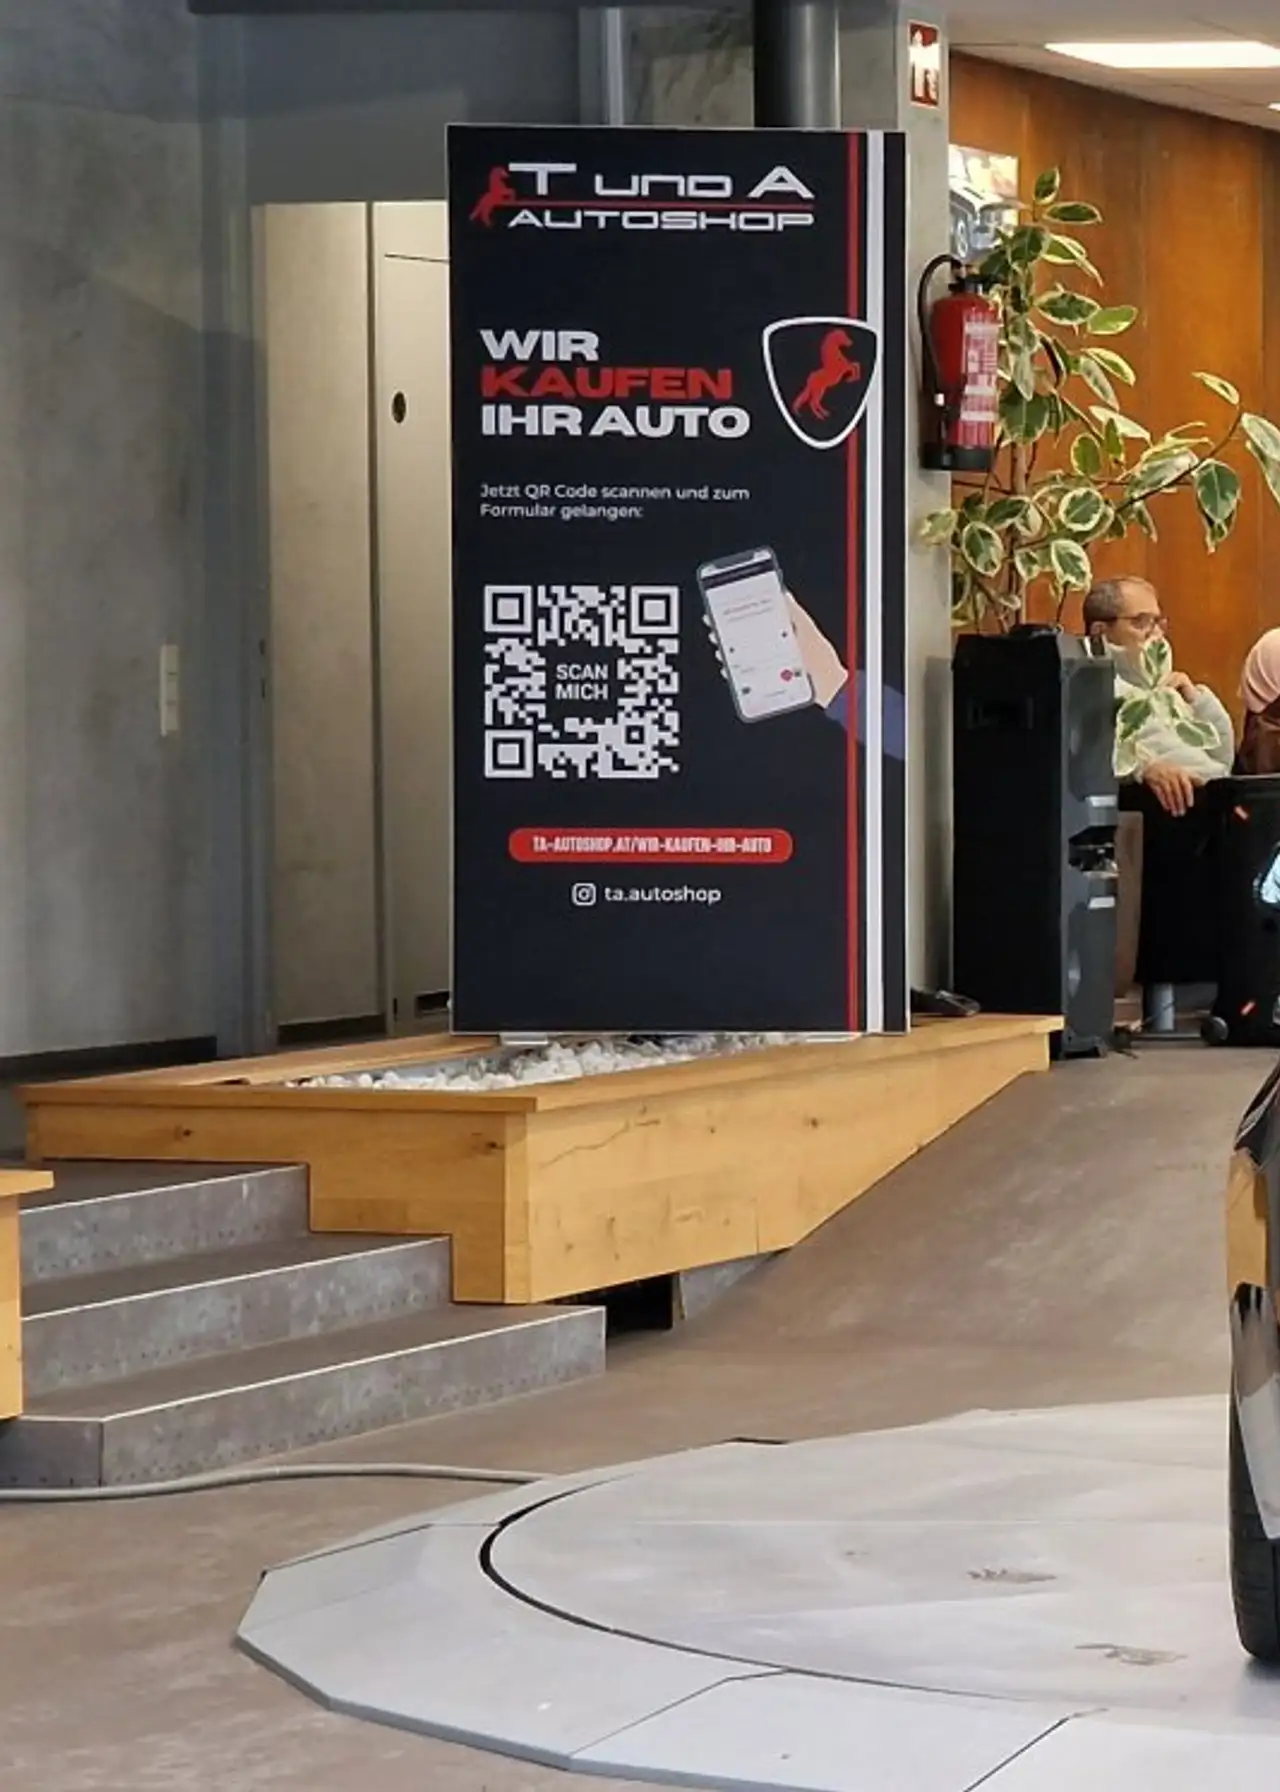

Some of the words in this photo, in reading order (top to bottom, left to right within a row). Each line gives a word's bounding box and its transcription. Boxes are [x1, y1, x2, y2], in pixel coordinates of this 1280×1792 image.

[507, 162, 578, 196] T
[746, 165, 817, 200] A
[507, 208, 816, 232] AUTOSHOP
[479, 329, 600, 362] WIR
[480, 366, 734, 400] KAUFEN
[481, 404, 583, 437] IHR
[587, 405, 752, 439] AUTO
[479, 483, 522, 499] Jetzt
[524, 483, 551, 500] QR
[554, 483, 598, 499] Code
[600, 485, 672, 500] scannen
[676, 485, 709, 500] und
[712, 488, 751, 500] zum
[479, 503, 557, 518] Formular
[559, 504, 644, 522] gelangen:
[555, 663, 609, 681] SCAN
[555, 684, 609, 701] MICH
[603, 884, 722, 905] ta.autoshop
